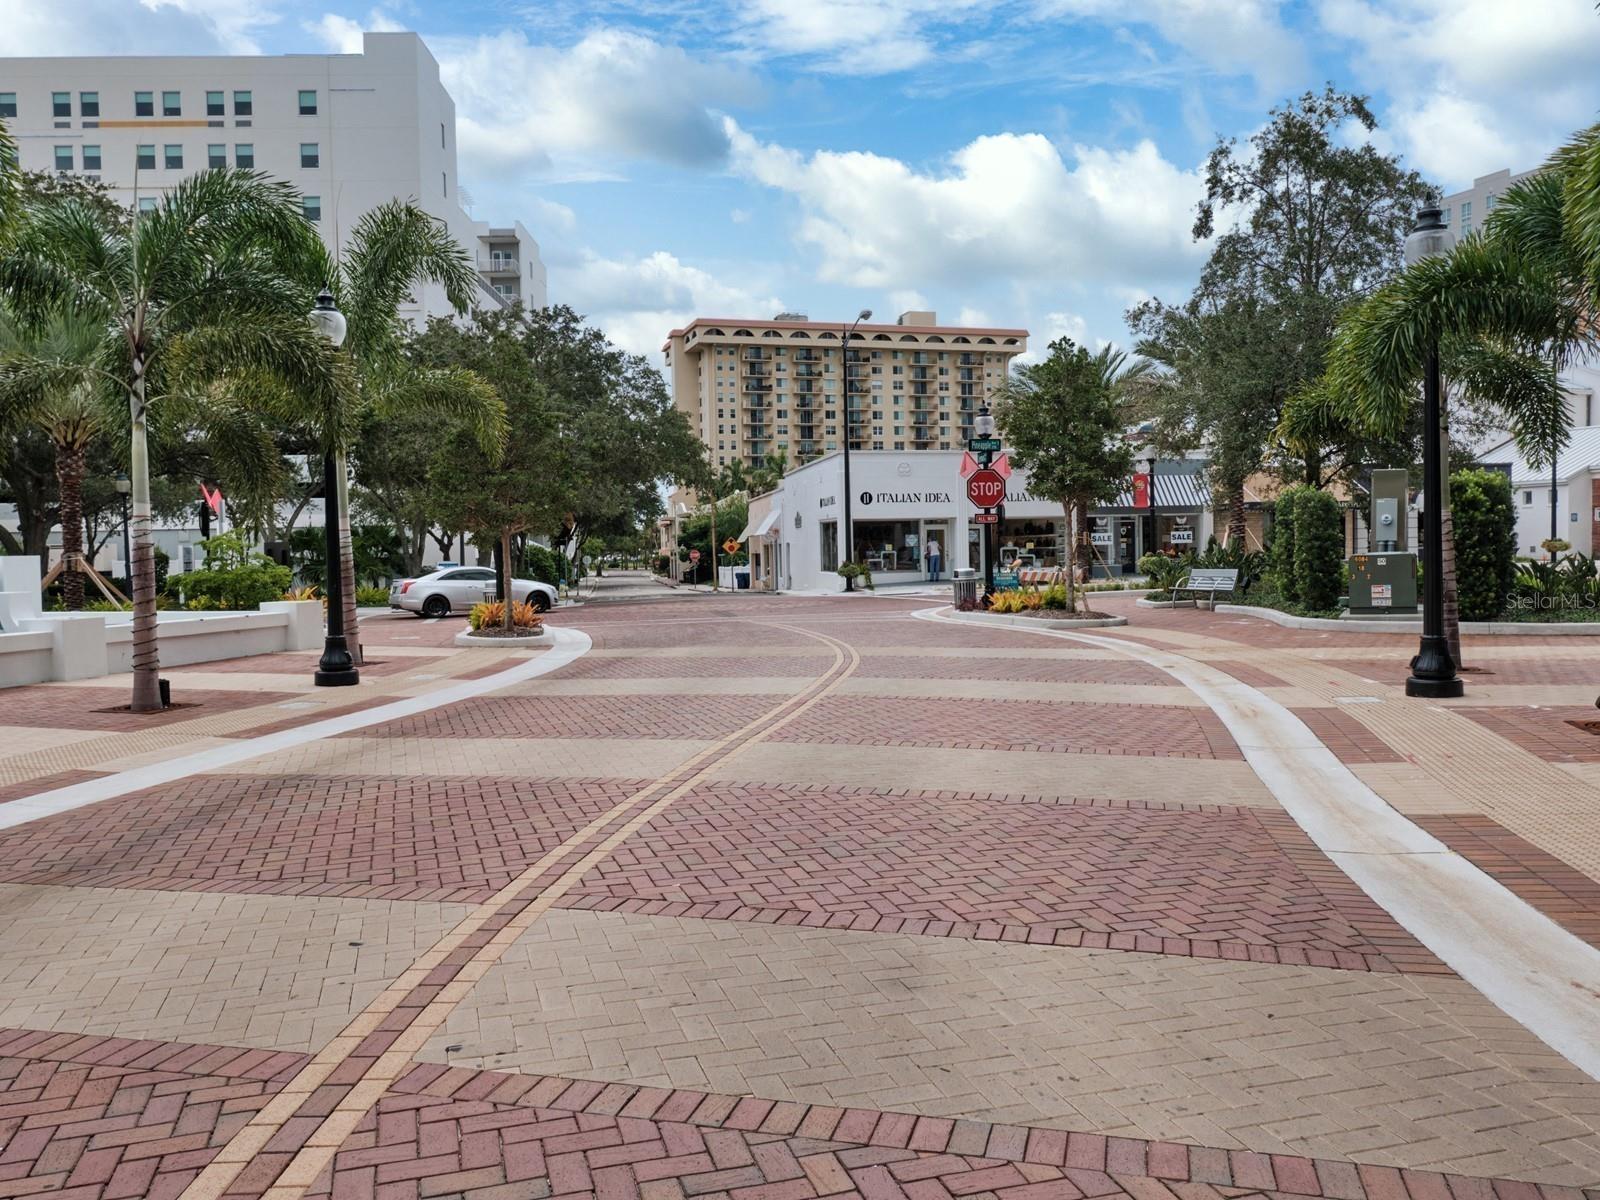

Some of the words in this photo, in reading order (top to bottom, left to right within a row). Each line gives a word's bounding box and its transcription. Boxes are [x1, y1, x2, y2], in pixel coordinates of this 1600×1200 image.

[971, 482, 1001, 496] STOP
[876, 493, 921, 503] ITALIAN
[925, 493, 951, 503] IDEA
[1172, 533, 1192, 541] SALE
